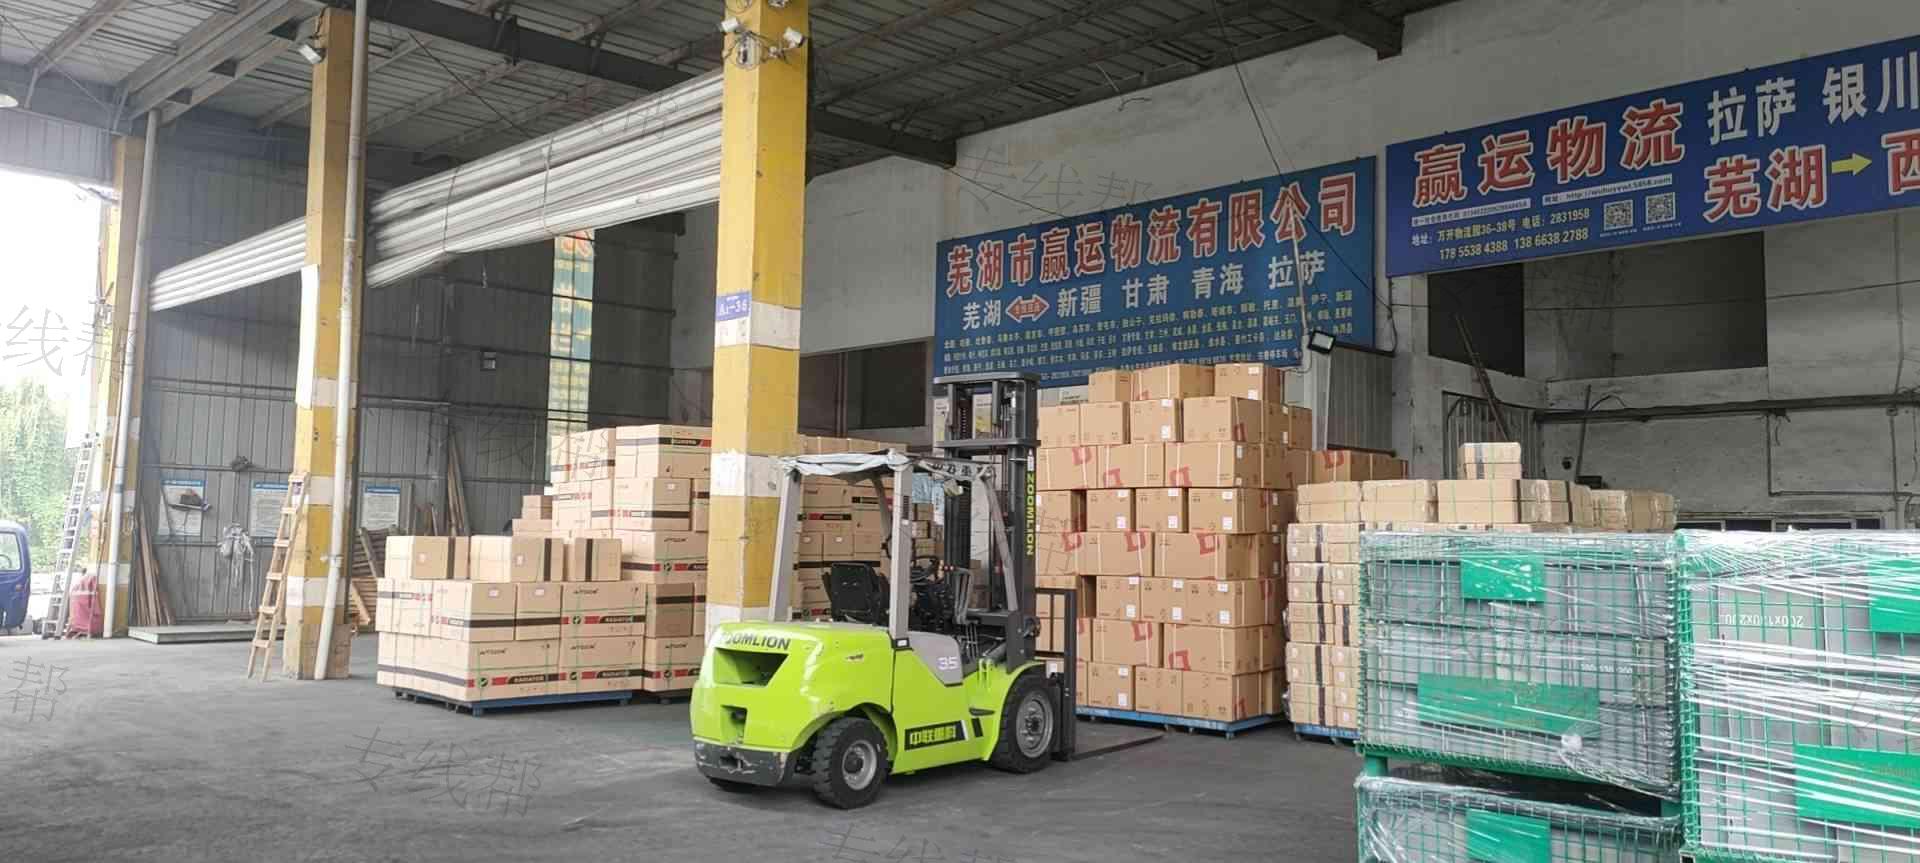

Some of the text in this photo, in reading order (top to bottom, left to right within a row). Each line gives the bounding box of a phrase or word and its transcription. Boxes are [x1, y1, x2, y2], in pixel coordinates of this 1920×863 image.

[1708, 77, 1795, 144] 拉萨
[1414, 99, 1685, 206] 赢运物流
[1703, 144, 1825, 222] 芜湖
[946, 173, 1356, 296] 芜湖市赢运物流有限公司
[1513, 238, 1532, 250] 138
[1562, 227, 1589, 243] 2788
[962, 300, 1002, 330] 芜湖
[1056, 284, 1103, 318] 新疆
[1122, 274, 1170, 307] 甘肃
[1191, 264, 1244, 302] 青海
[1026, 474, 1036, 556] ZOOMLION
[938, 656, 958, 670] 35
